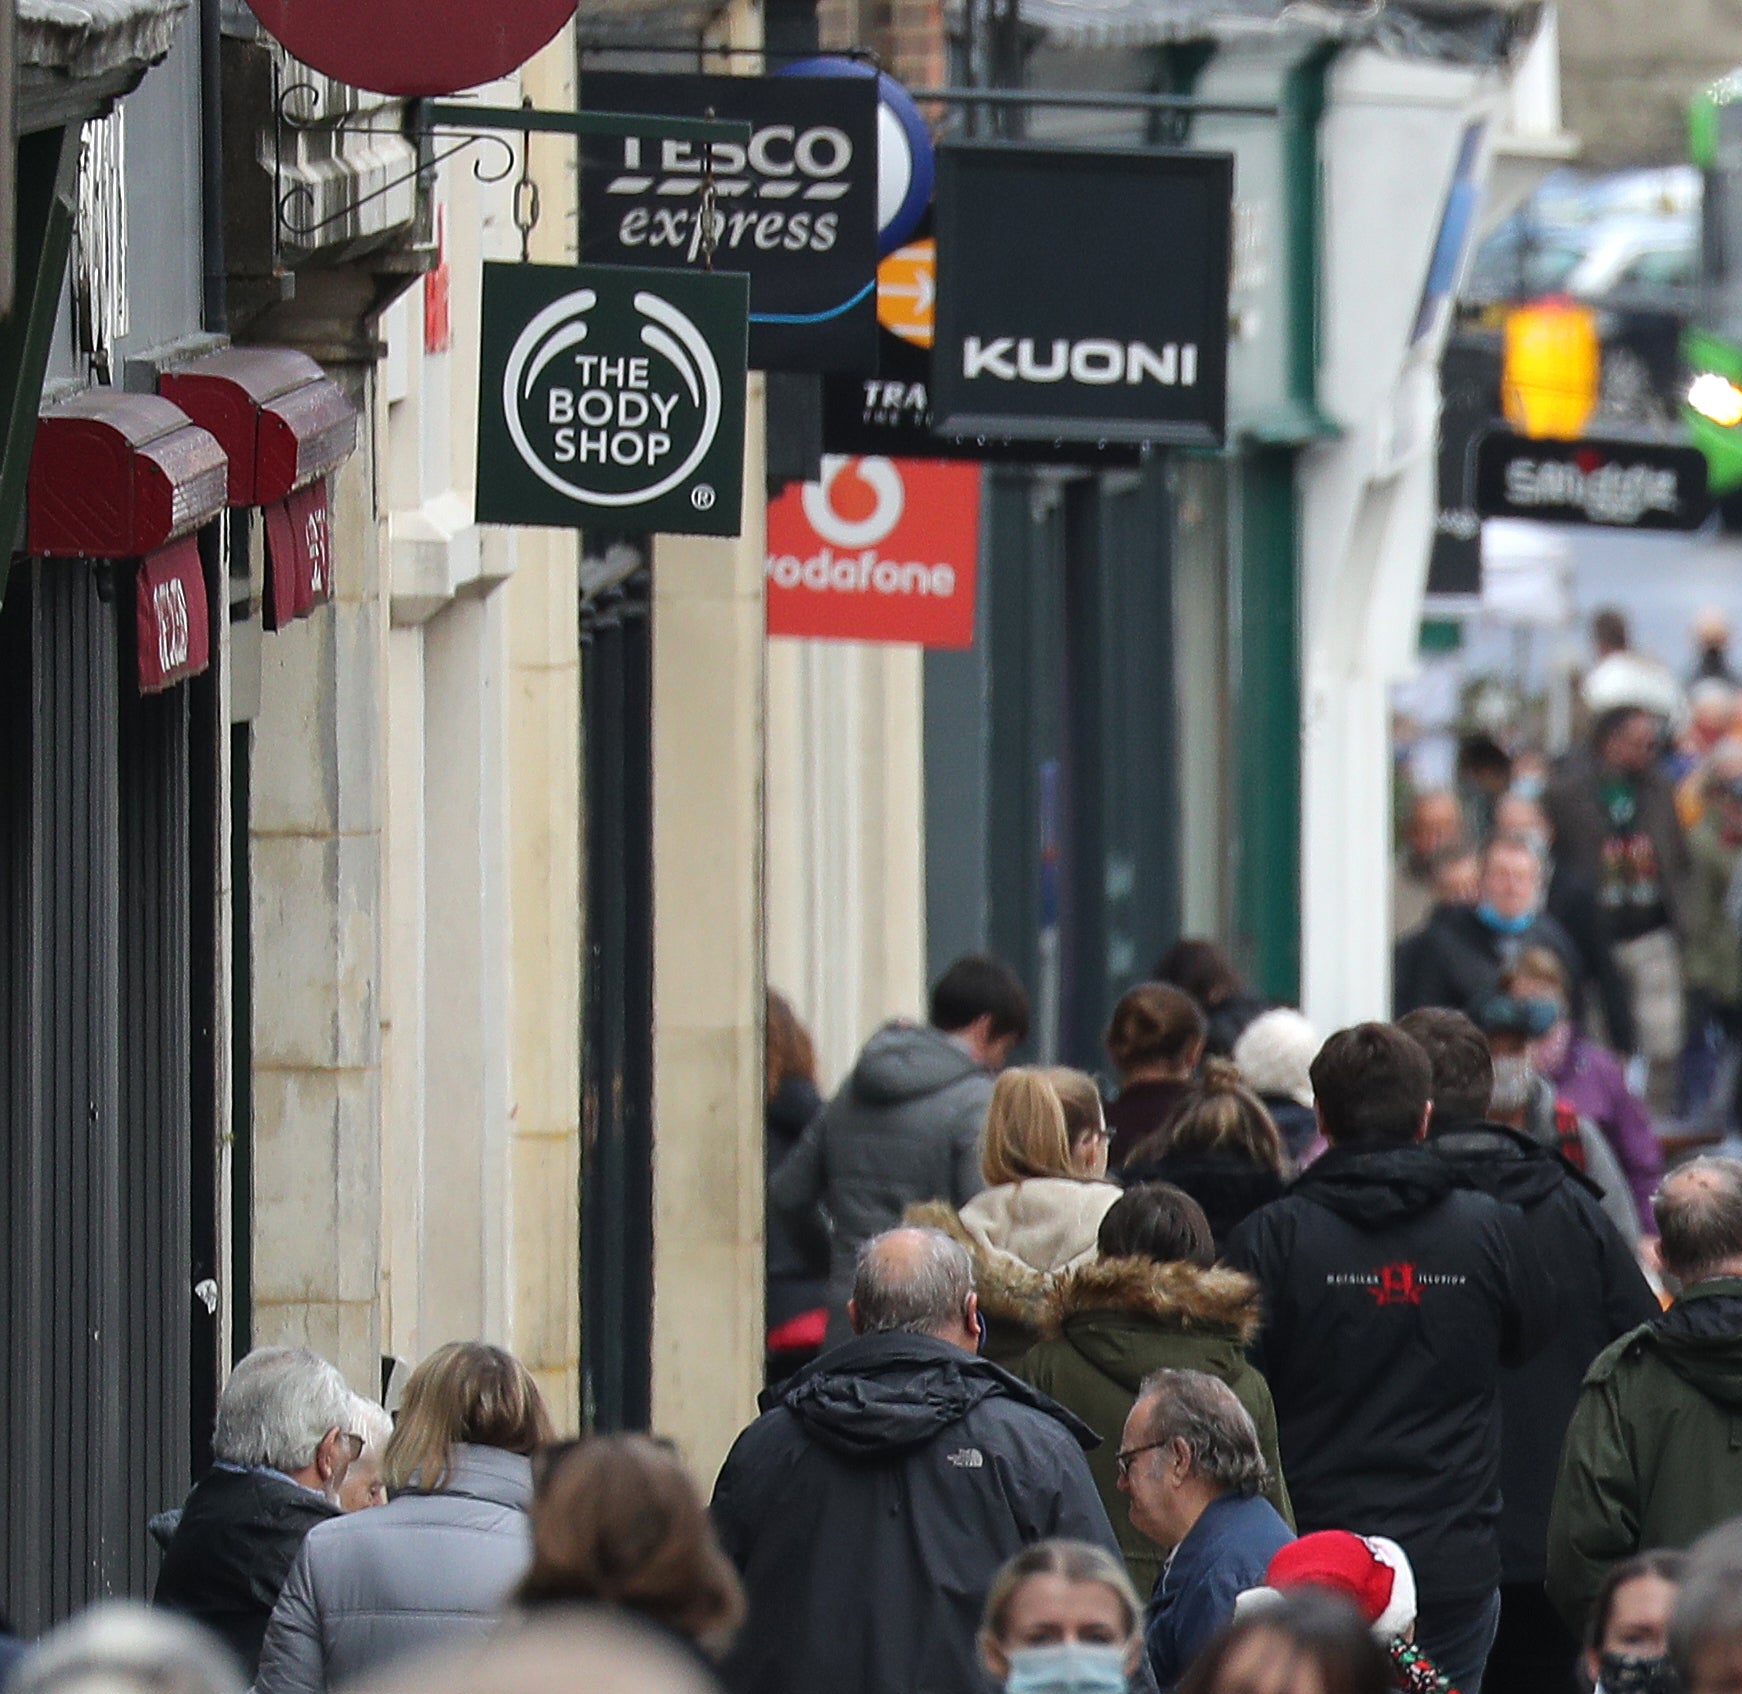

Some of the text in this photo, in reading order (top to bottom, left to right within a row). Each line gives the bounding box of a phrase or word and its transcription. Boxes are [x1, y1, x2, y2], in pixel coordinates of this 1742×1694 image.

[618, 206, 840, 263] express
[574, 354, 650, 390] THE
[962, 336, 1198, 387] KUONI
[548, 387, 680, 430] BODY
[553, 426, 672, 467] SHOP
